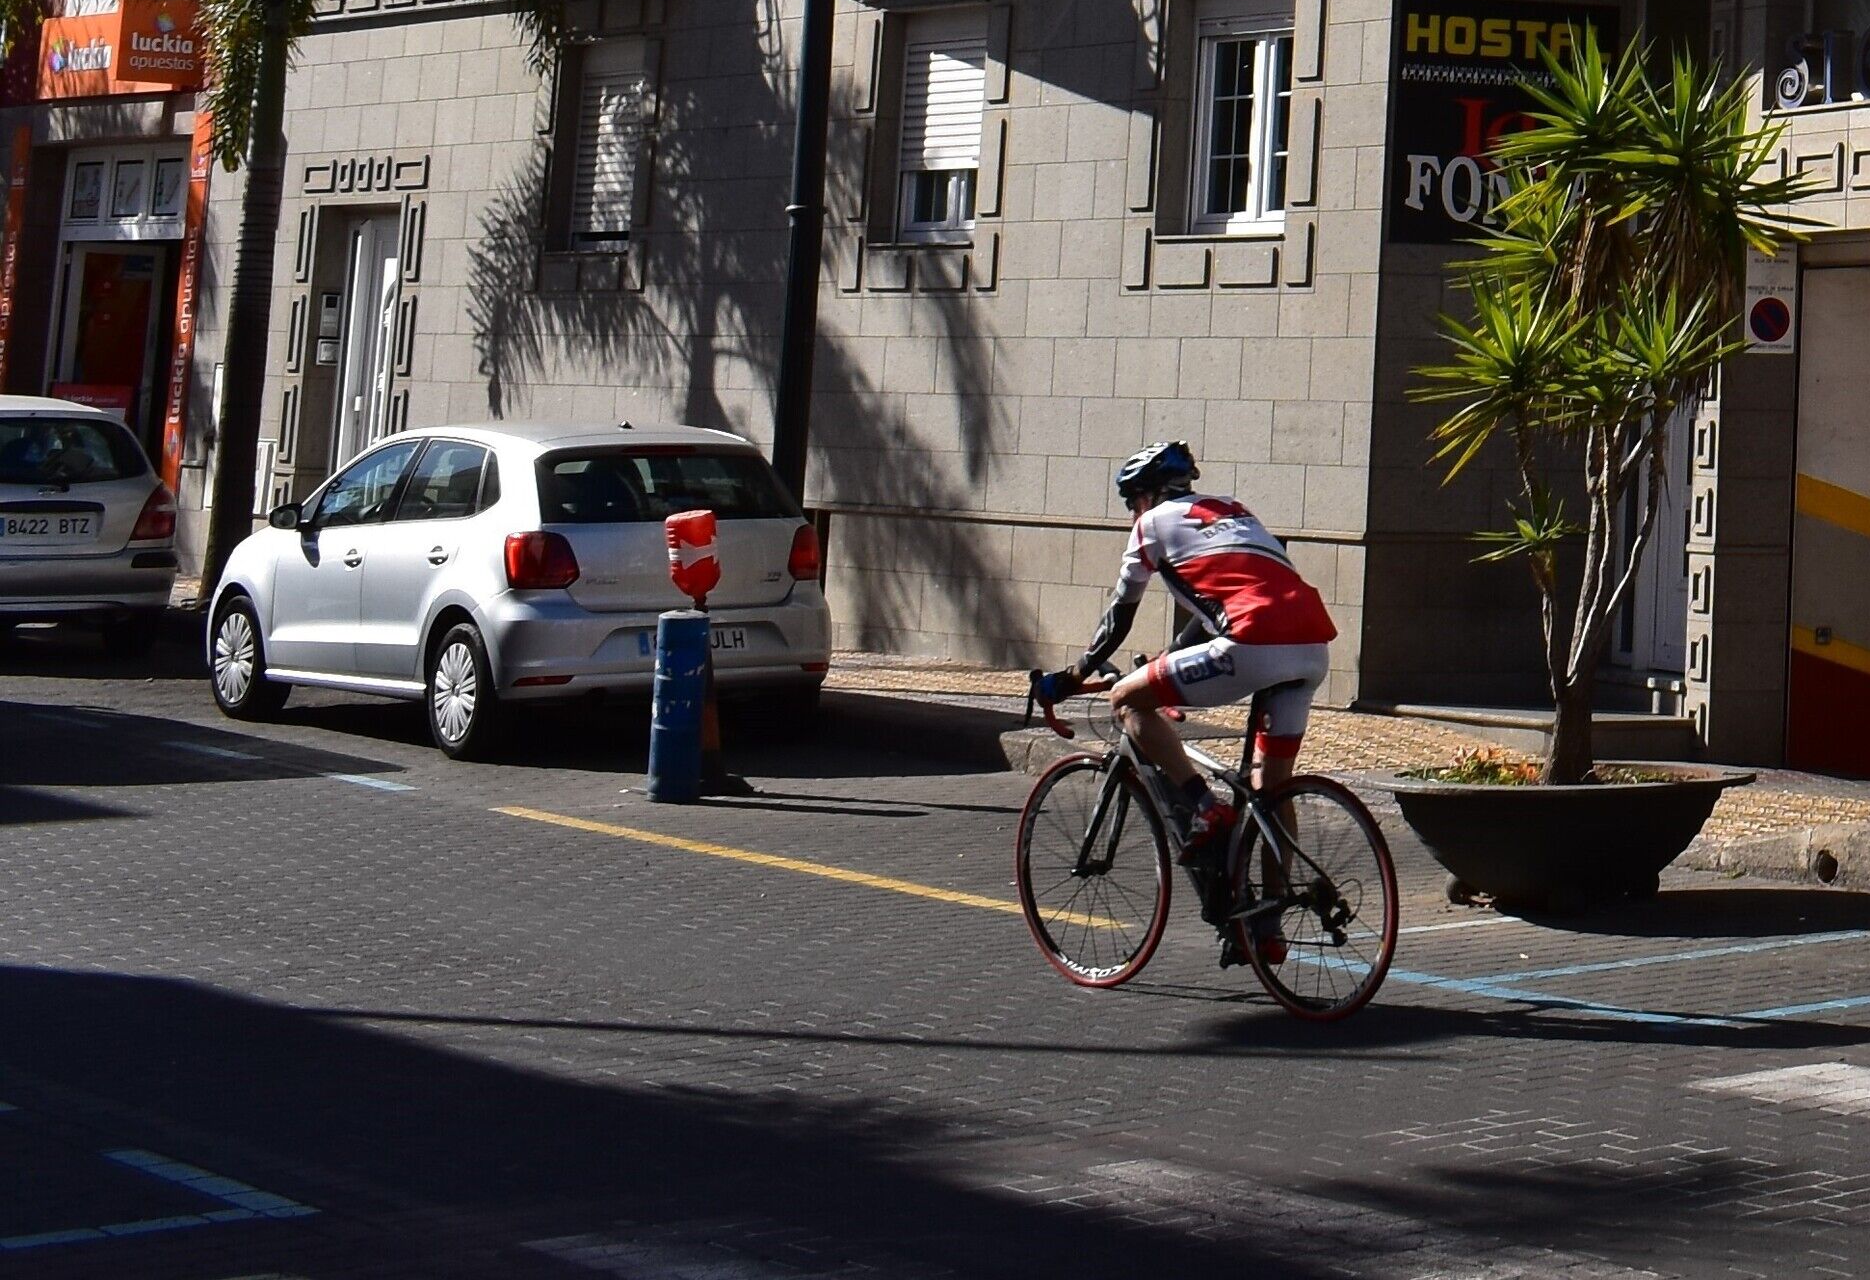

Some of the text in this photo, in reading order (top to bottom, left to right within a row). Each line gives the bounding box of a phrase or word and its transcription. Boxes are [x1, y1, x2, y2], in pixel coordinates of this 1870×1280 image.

[131, 32, 194, 55] luckia
[130, 54, 195, 71] apuestas
[167, 342, 187, 424] luckia
[7, 519, 90, 535] 8422 BTZ
[711, 630, 745, 649] JLH
